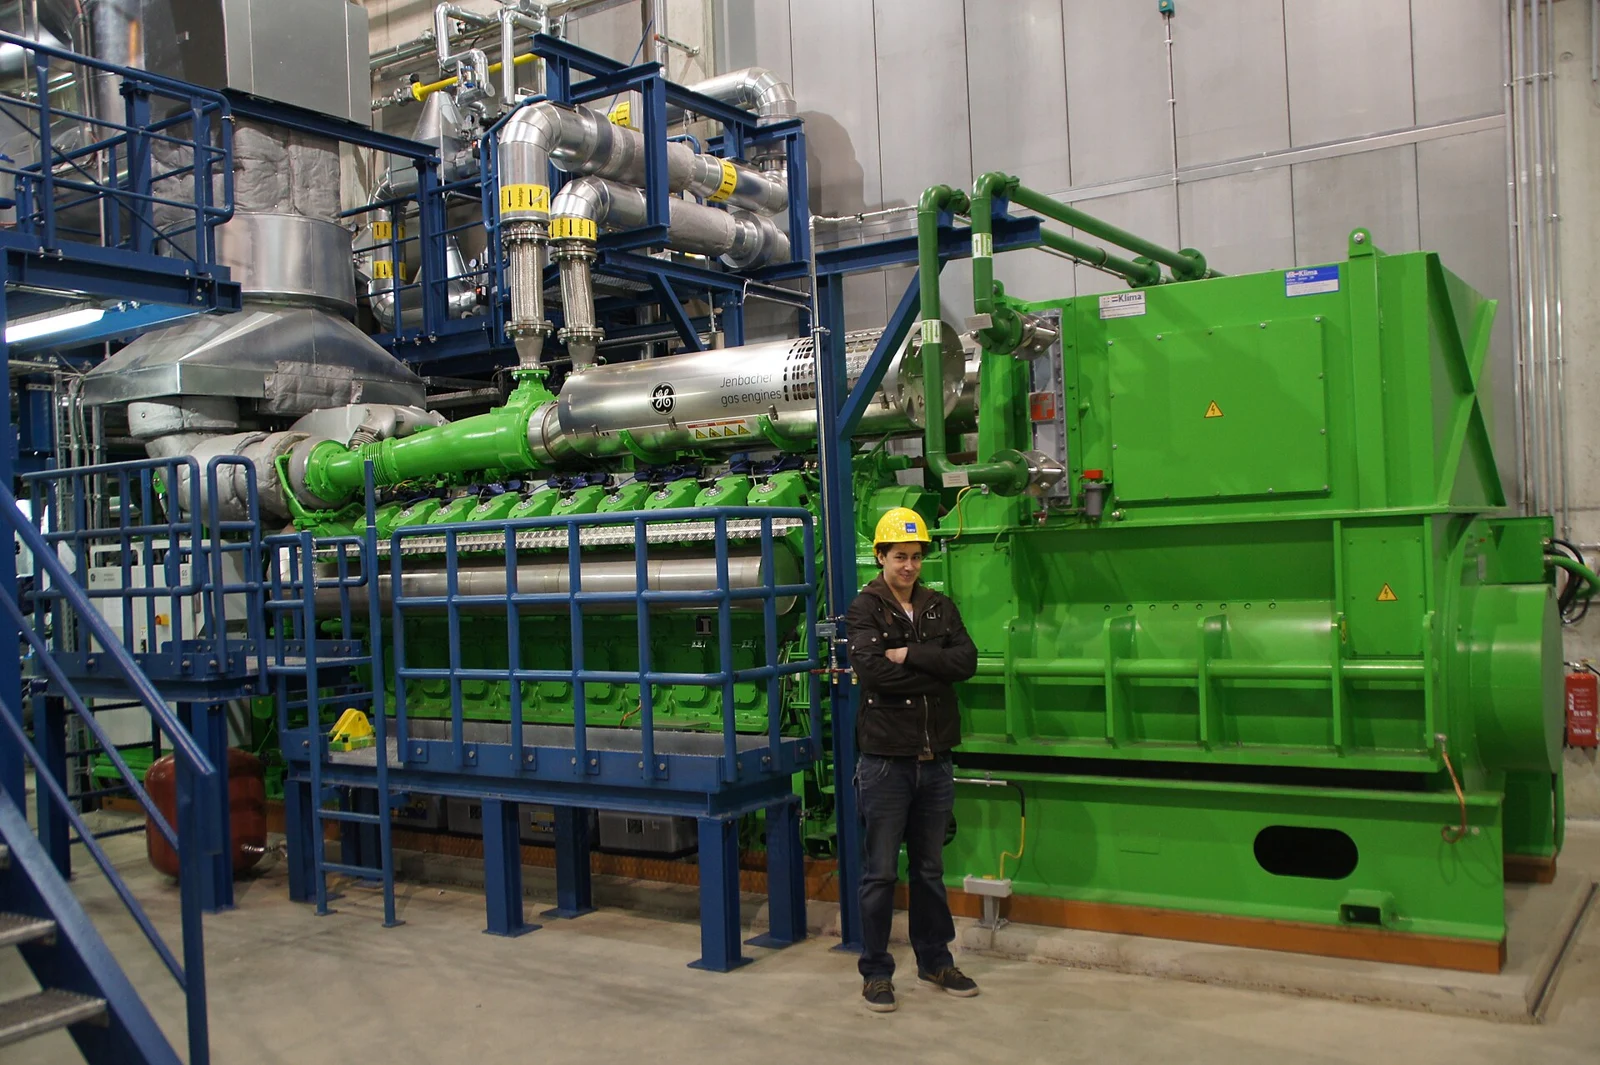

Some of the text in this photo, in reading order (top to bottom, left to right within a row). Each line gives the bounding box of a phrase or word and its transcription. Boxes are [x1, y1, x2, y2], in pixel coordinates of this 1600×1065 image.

[720, 373, 773, 388] Jenbacher
[721, 389, 782, 407] gas engines
